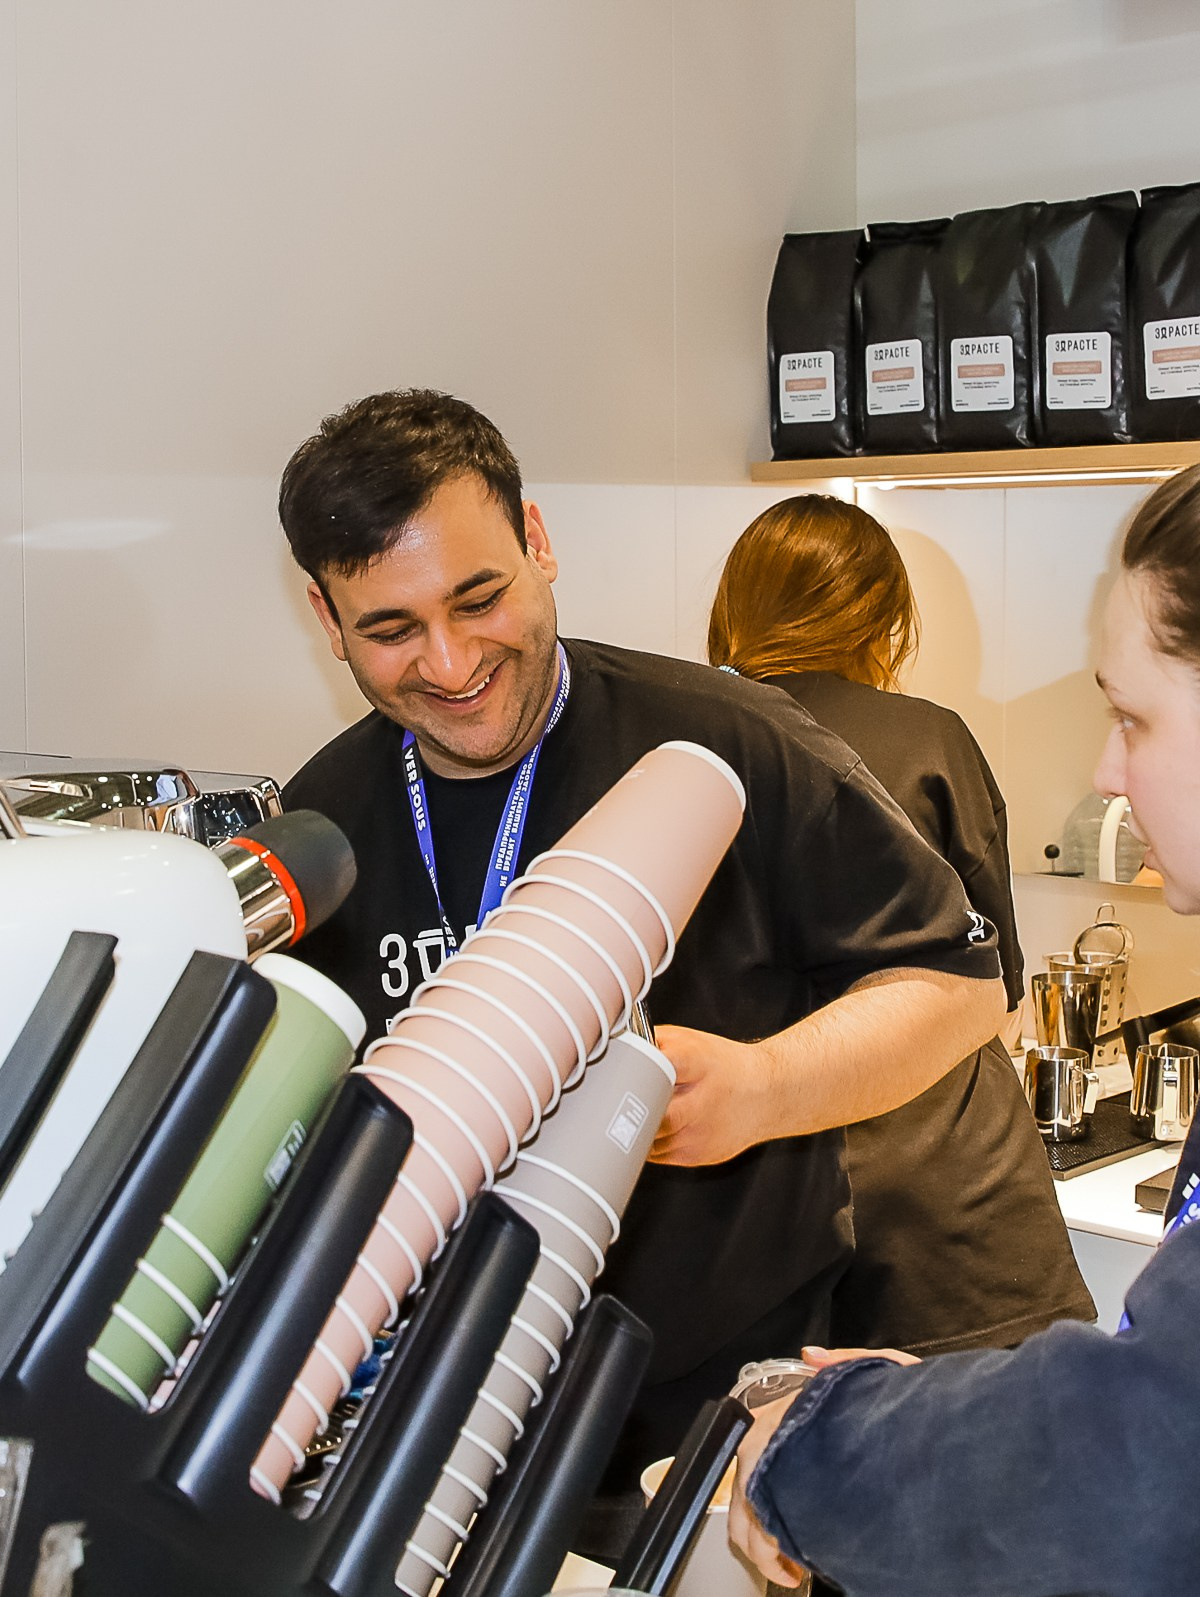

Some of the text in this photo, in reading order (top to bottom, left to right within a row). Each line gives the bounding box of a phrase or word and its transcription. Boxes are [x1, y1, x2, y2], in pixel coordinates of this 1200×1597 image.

[495, 763, 527, 870] ПРЕДПРИНИМАТЕЛЬСТВО
[502, 839, 516, 872] ВРЕДИТ
[511, 796, 525, 834] ВАШЕМУ
